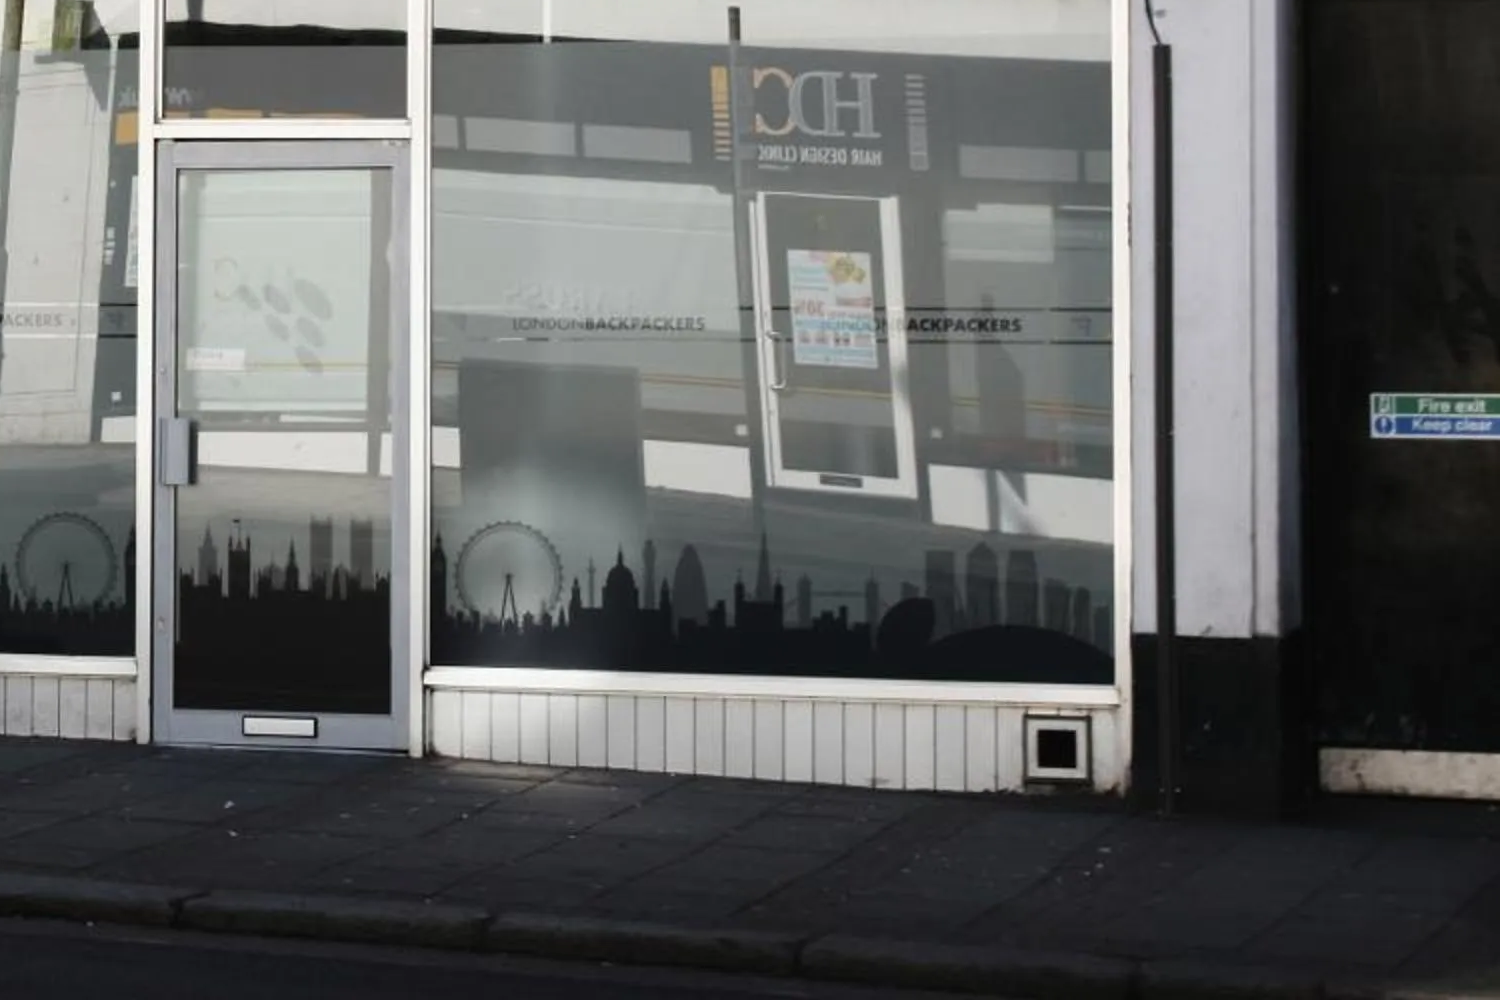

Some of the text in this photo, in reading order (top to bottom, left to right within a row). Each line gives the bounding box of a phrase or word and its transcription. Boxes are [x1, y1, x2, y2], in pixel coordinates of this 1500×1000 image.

[1418, 398, 1486, 413] Fire exit
[1411, 415, 1492, 434] Keep clear
